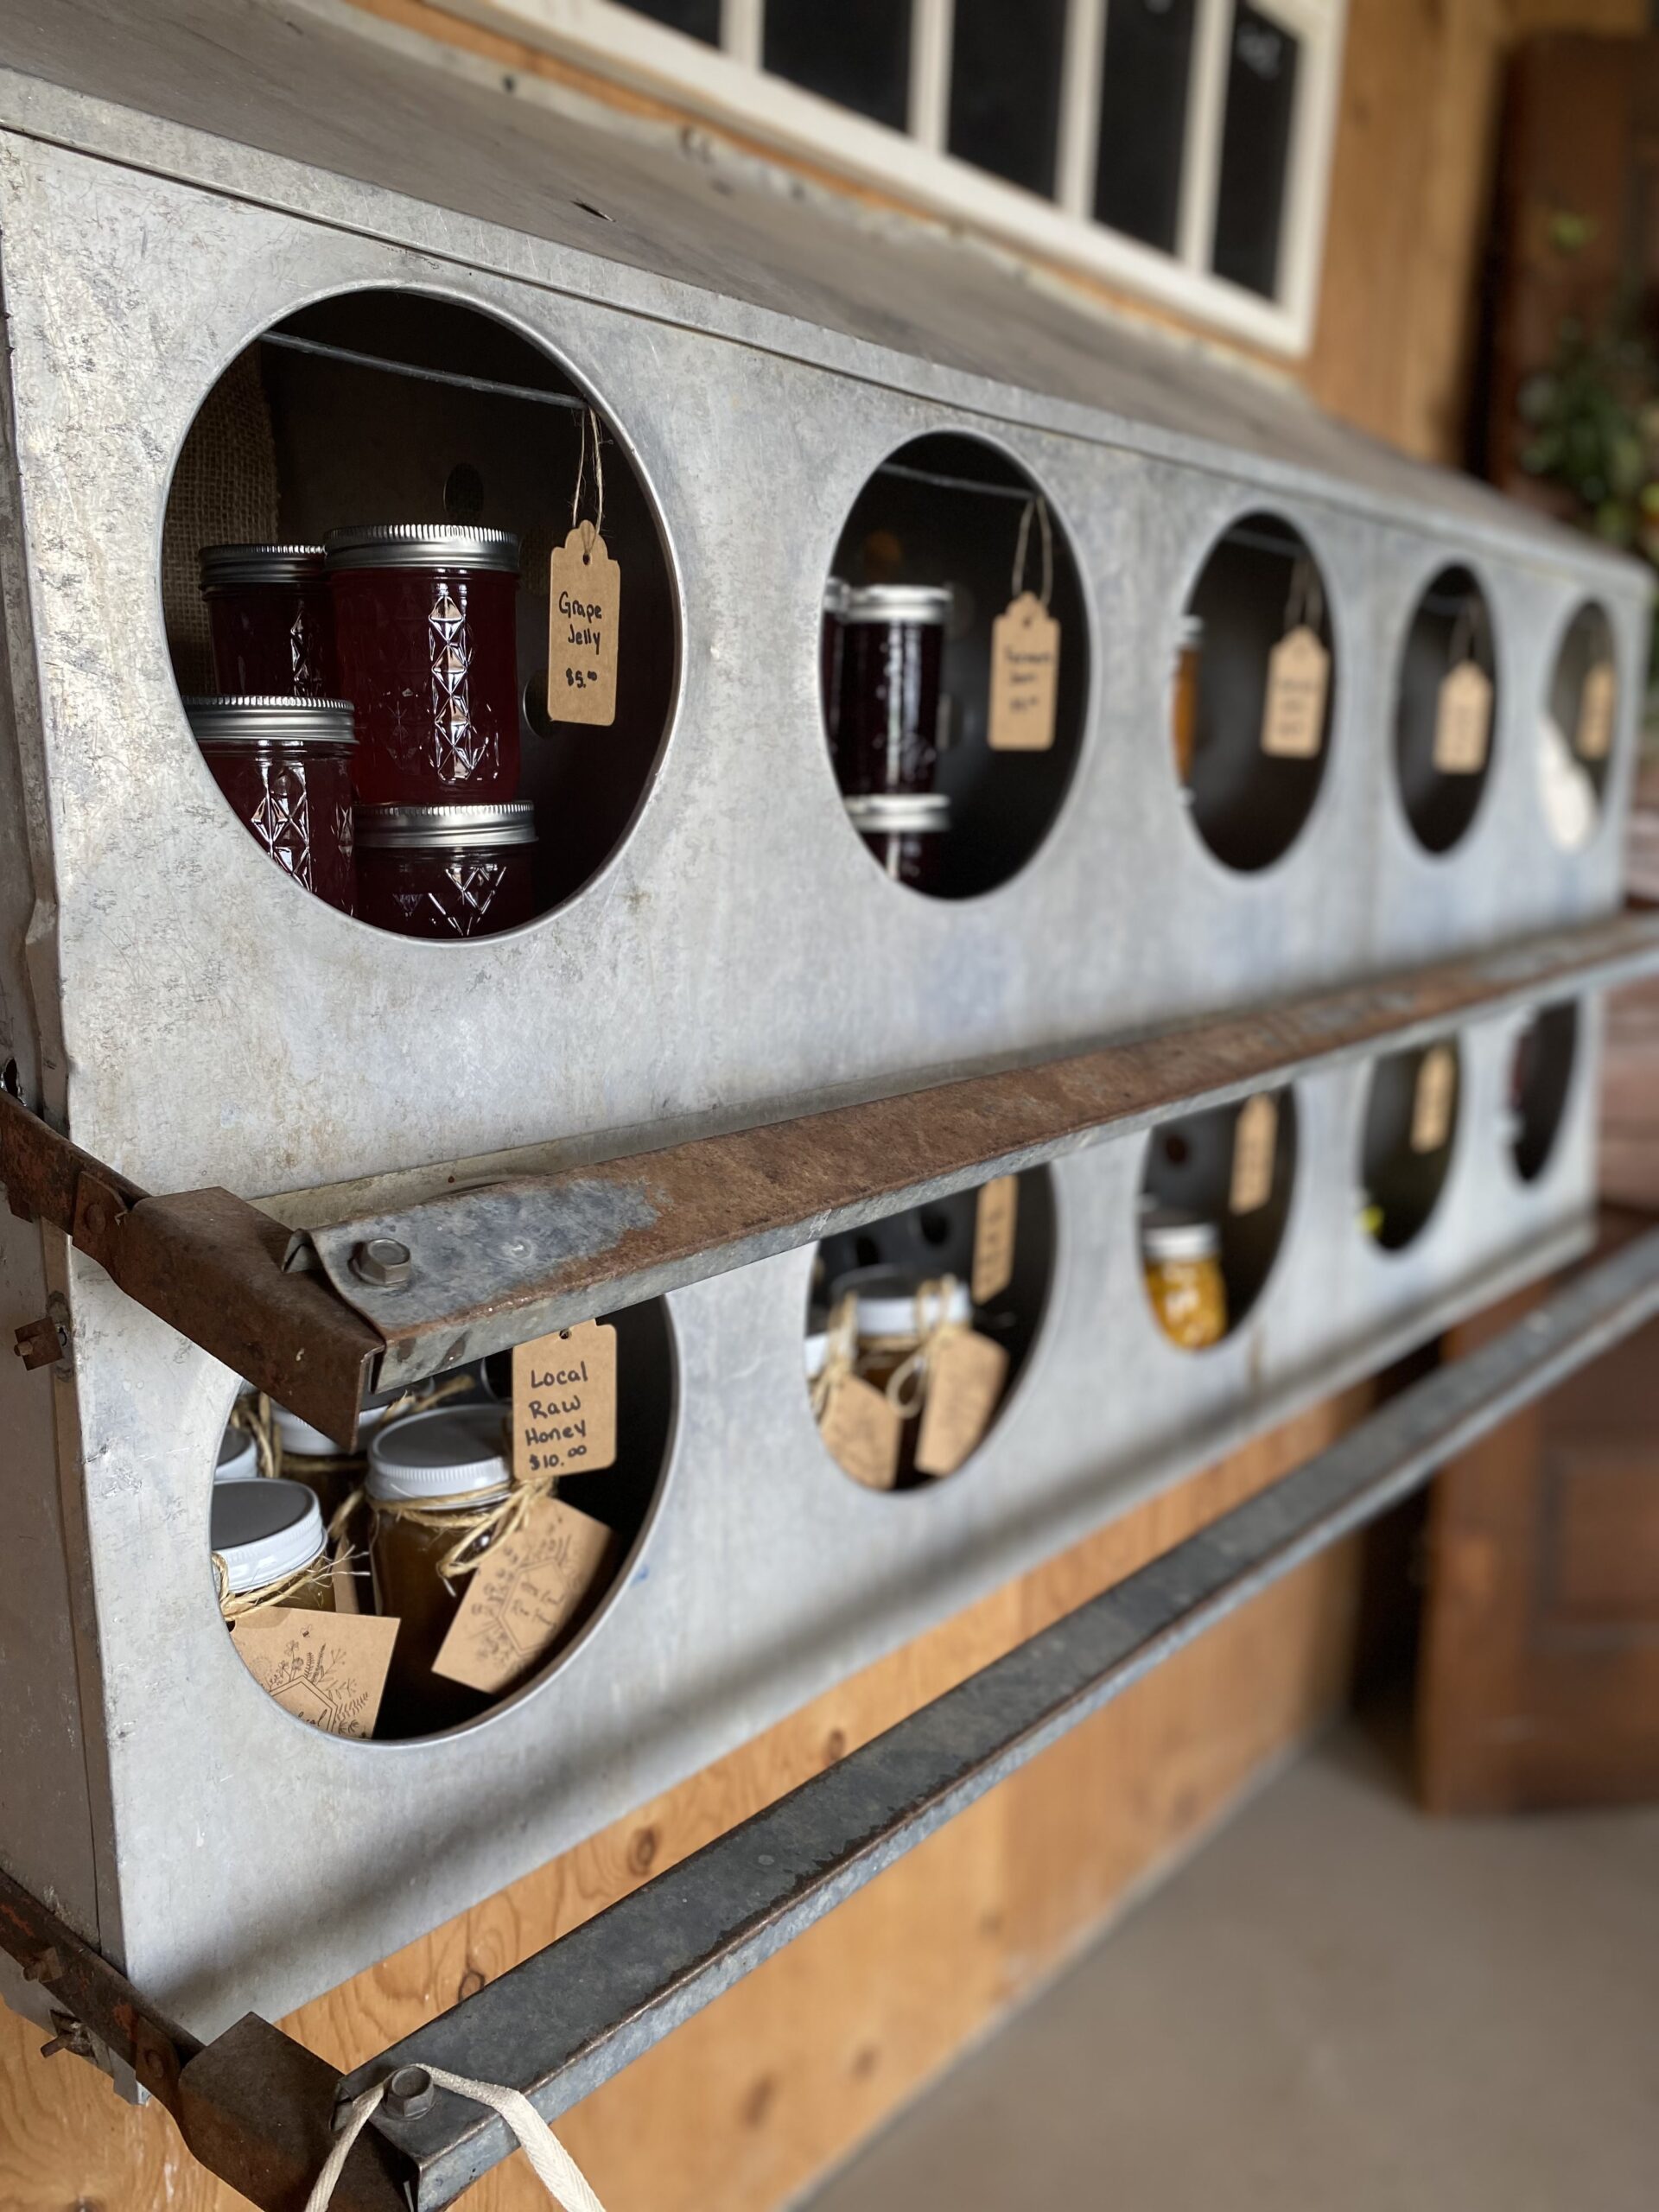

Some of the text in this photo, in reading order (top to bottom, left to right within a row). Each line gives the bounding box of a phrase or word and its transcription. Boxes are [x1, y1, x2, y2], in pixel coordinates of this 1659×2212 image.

[559, 591, 602, 623] Grape
[568, 624, 601, 655] Jelly
[531, 1360, 588, 1389] Local
[528, 1395, 582, 1420] Raw
[524, 1419, 587, 1446] Honey
[529, 1444, 588, 1471] $10.00
